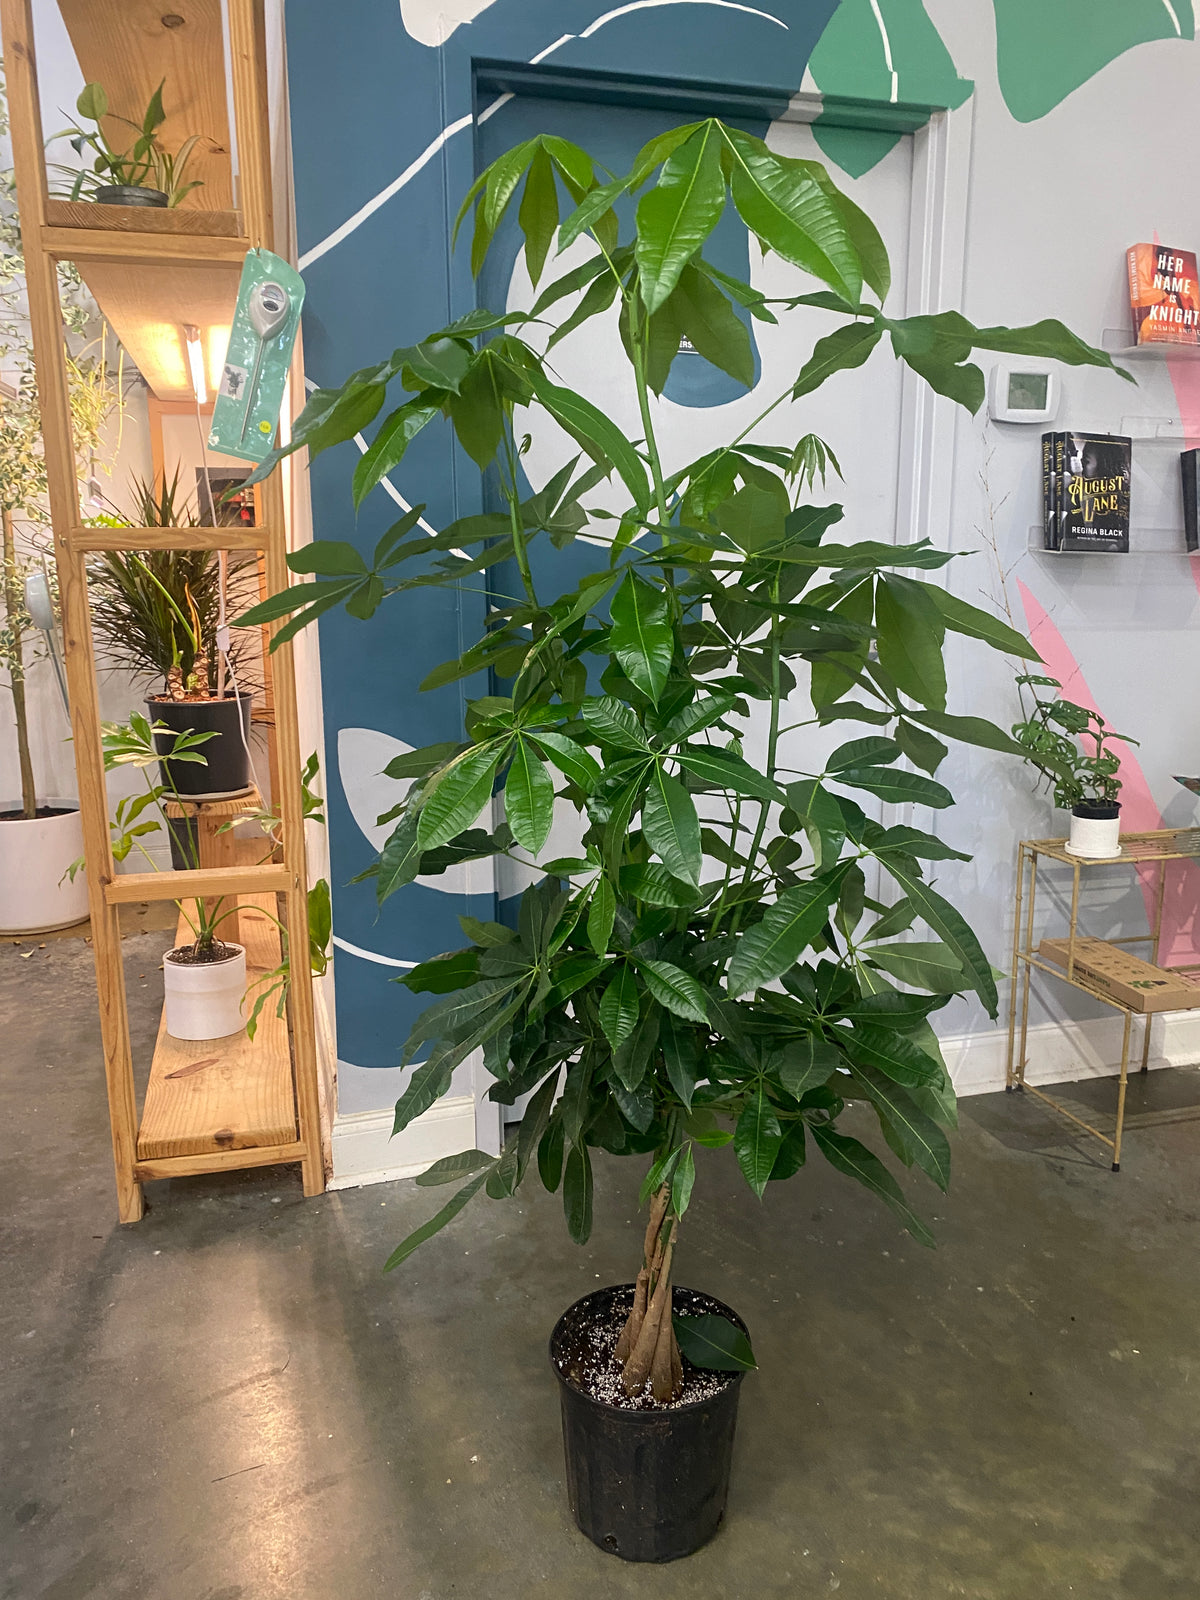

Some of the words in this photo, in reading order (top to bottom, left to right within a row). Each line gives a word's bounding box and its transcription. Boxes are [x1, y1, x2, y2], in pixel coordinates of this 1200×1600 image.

[1157, 254, 1183, 273] HER
[1152, 274, 1192, 294] NAME
[1169, 294, 1177, 303] IS
[1149, 305, 1200, 326] KNIGHT
[1149, 324, 1176, 333] YASMIN
[1068, 475, 1125, 506] AUGUST
[1085, 494, 1119, 522] LANE
[1071, 526, 1098, 535] REGINA
[1099, 528, 1123, 537] BLACK
